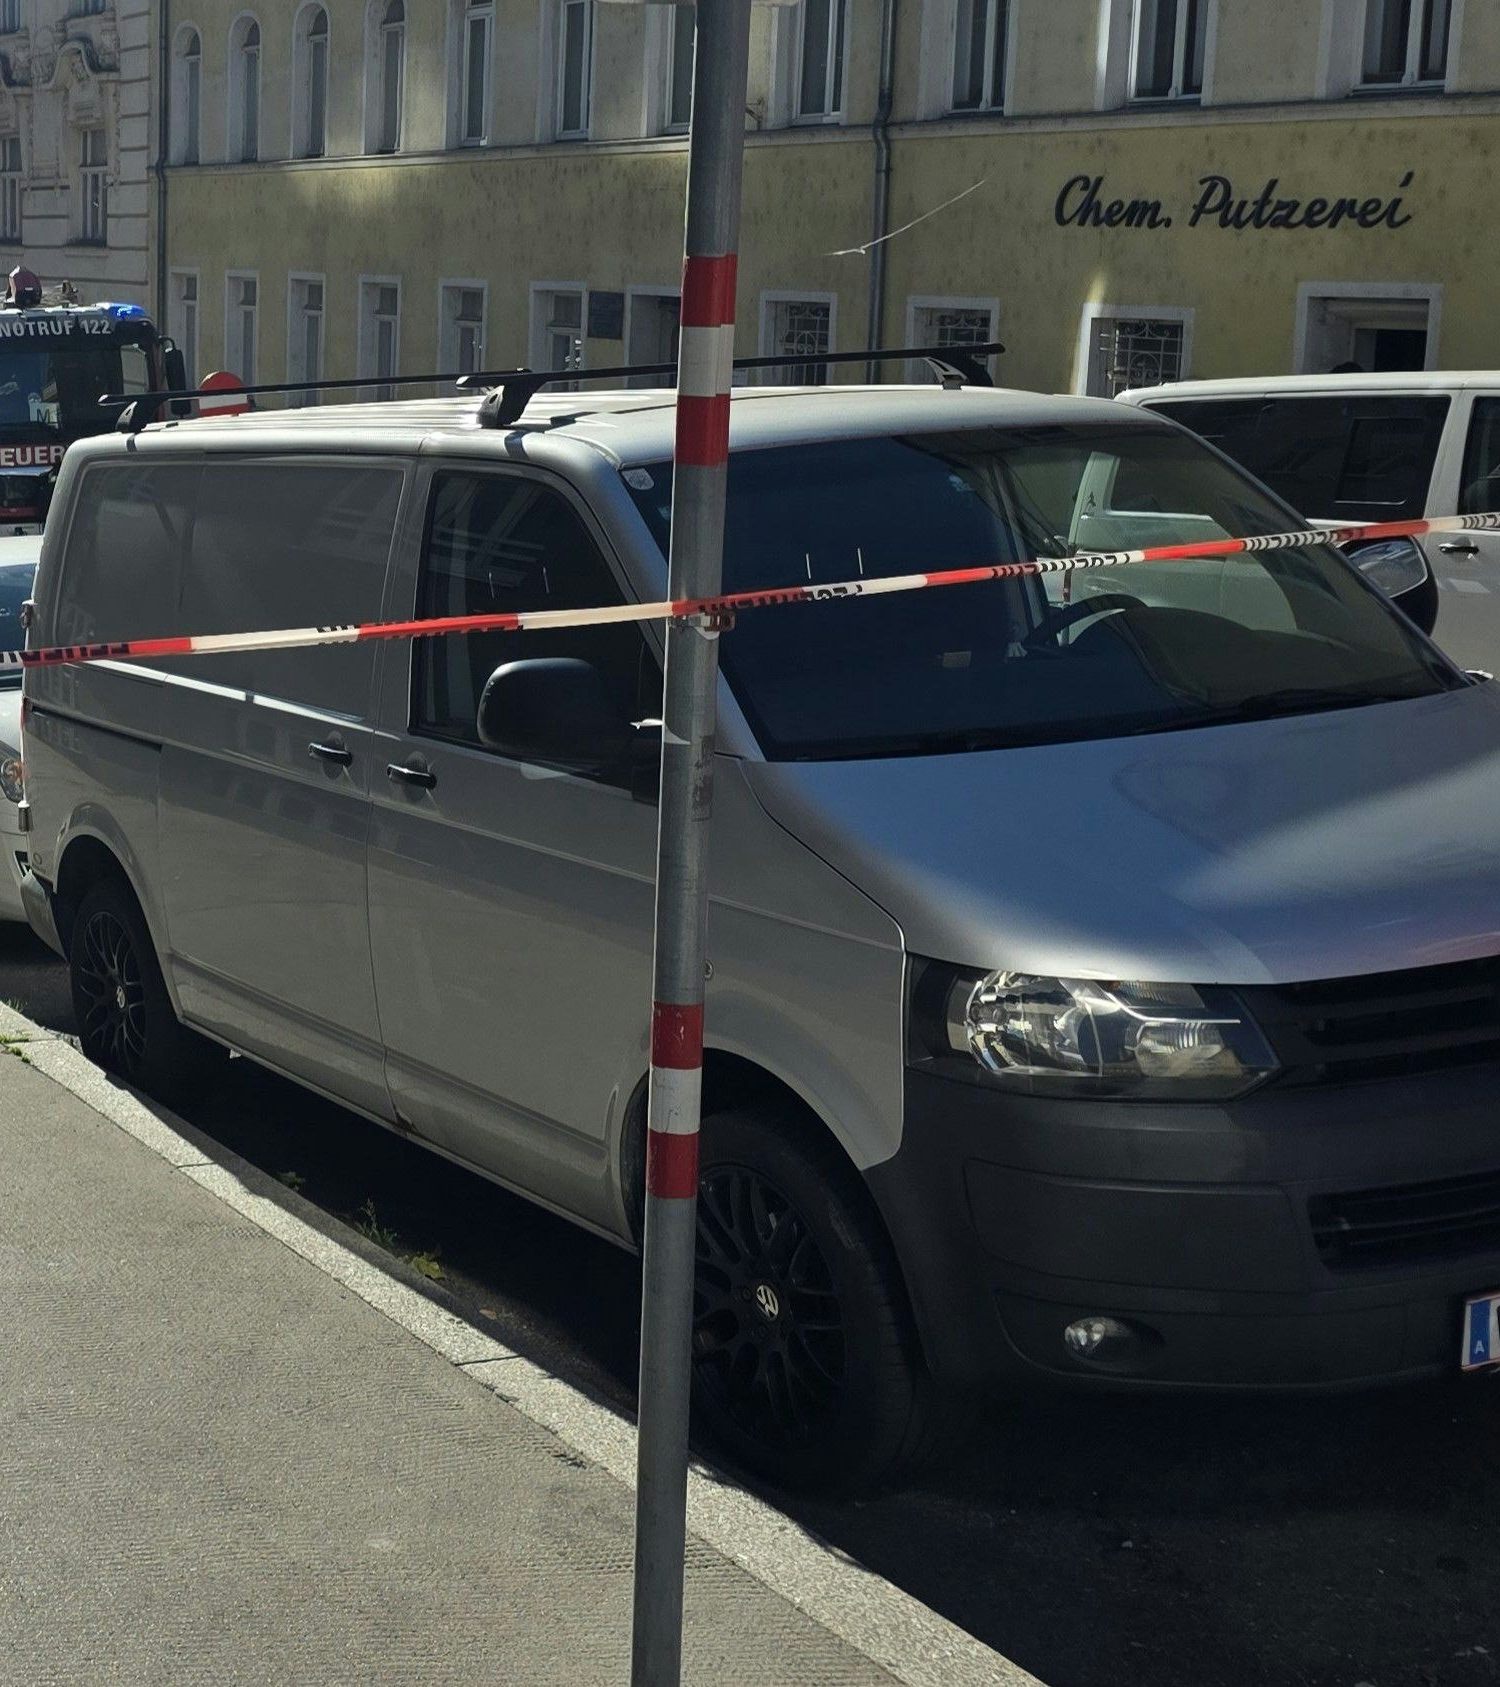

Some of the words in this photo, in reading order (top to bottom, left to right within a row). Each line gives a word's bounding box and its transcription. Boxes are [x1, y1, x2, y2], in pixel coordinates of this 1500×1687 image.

[1054, 175, 1172, 228] Chem.
[1188, 171, 1415, 229] Putzerei
[80, 318, 112, 335] 122
[1474, 1340, 1485, 1355] A
